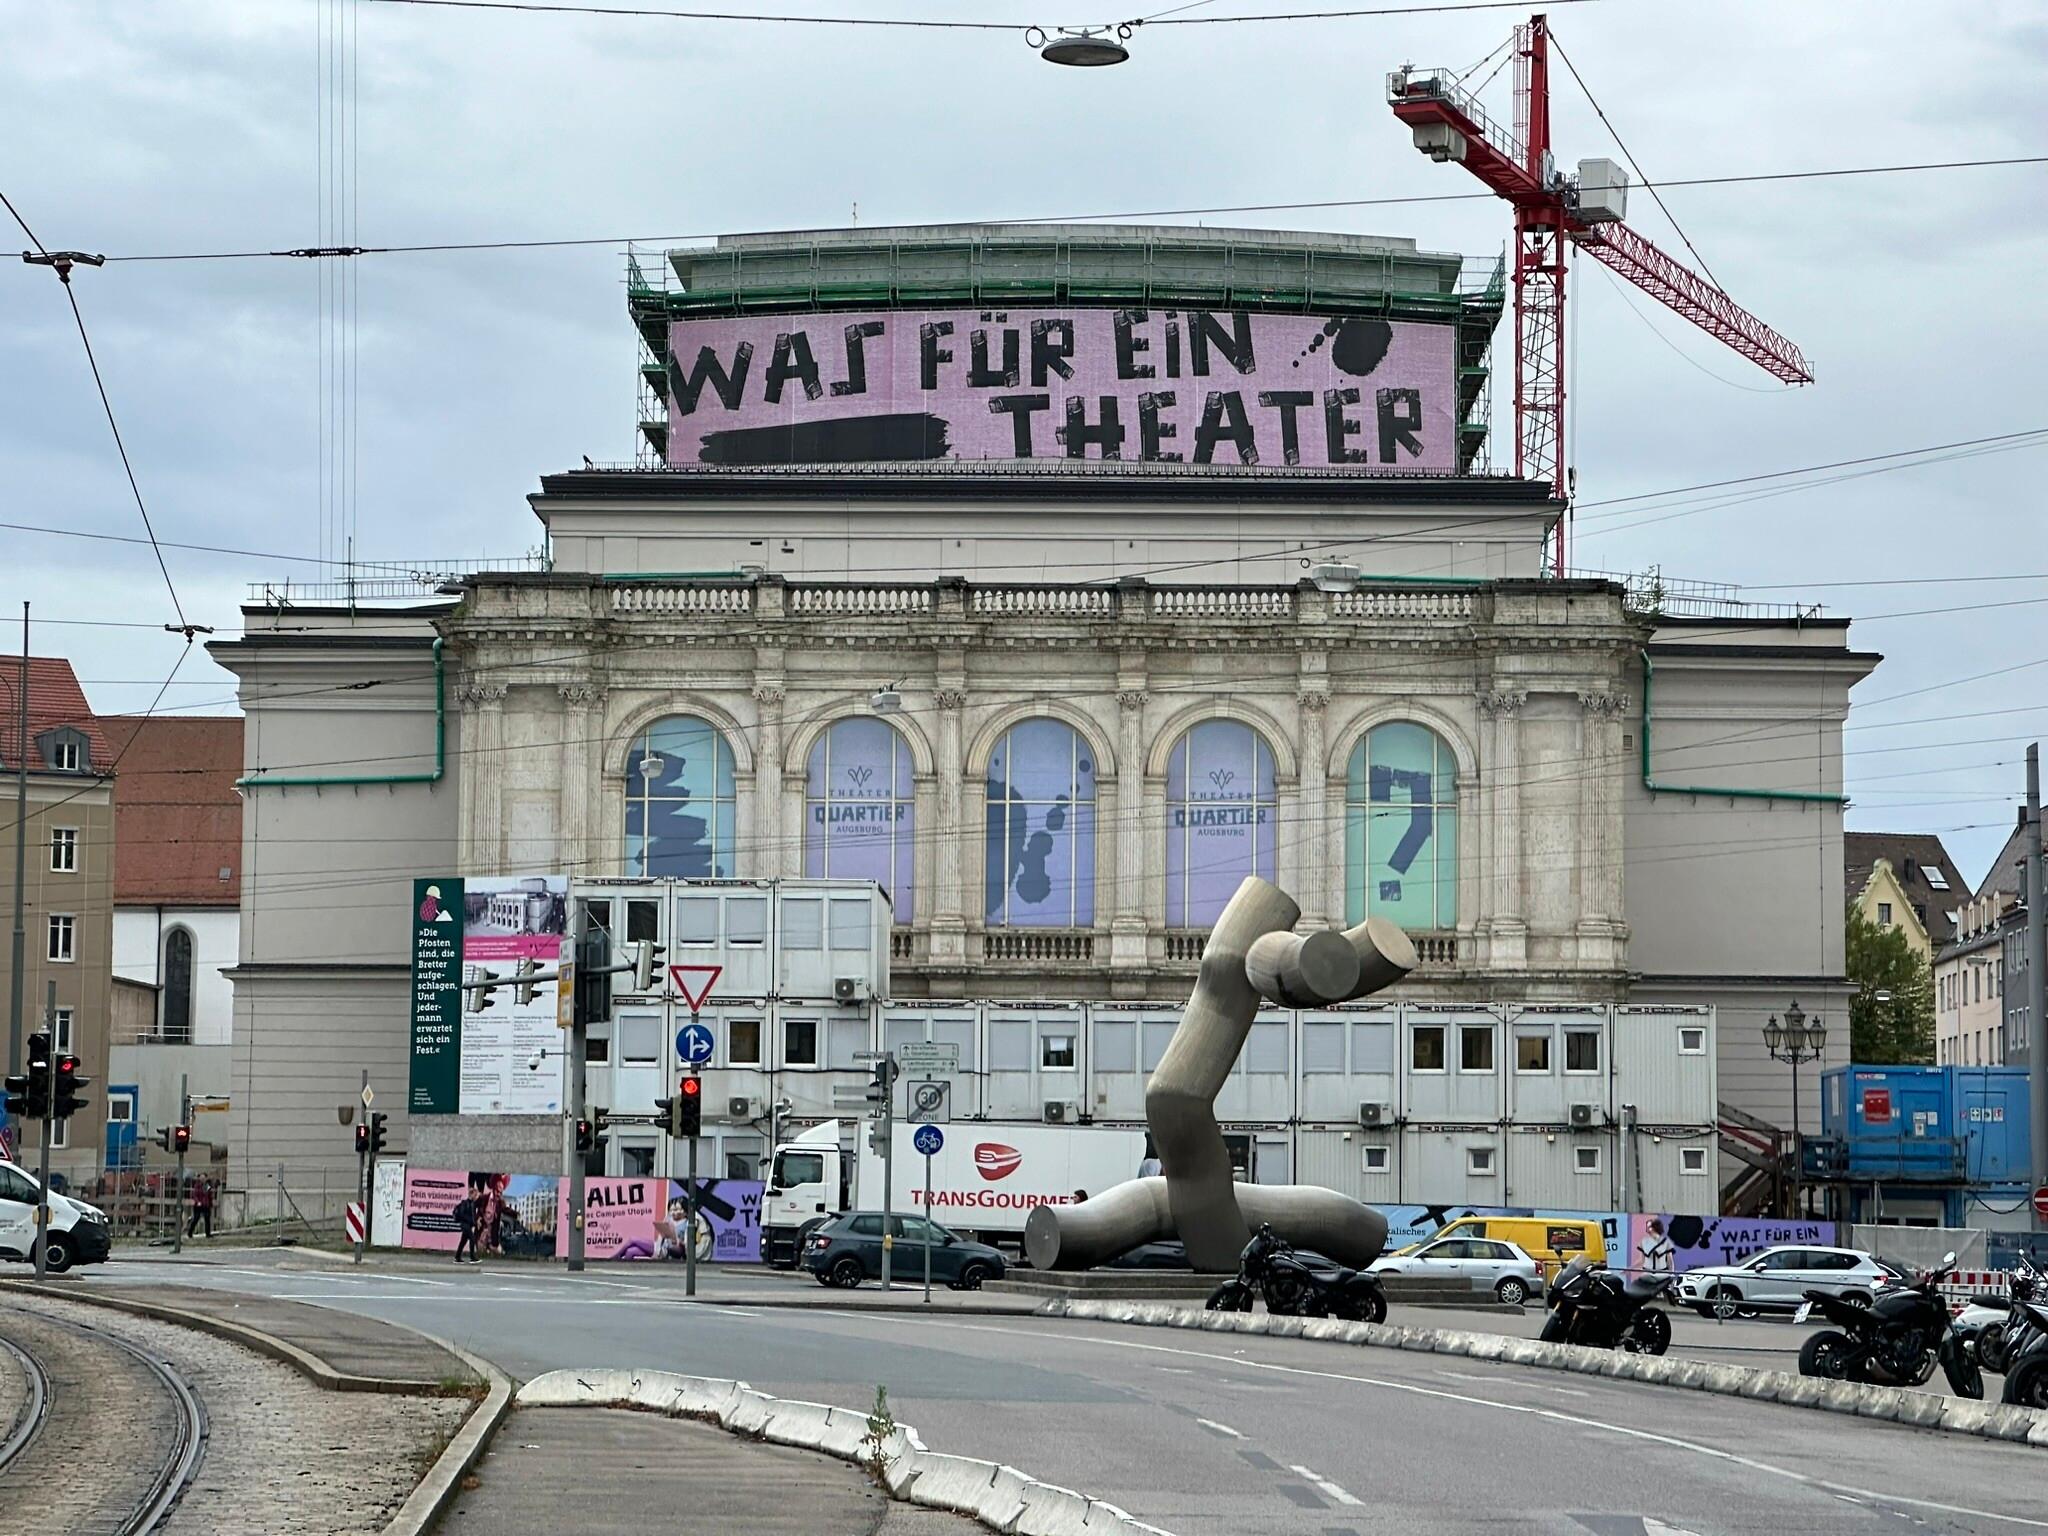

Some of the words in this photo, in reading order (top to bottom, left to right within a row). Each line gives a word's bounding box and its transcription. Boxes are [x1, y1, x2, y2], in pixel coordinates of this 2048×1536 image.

[669, 320, 885, 417] WAS
[920, 311, 1076, 390] FÜR
[988, 388, 1425, 467] THEATER
[829, 789, 891, 797] THEATER
[1190, 792, 1252, 800] THEATER
[836, 825, 883, 834] AUGSBURG
[1197, 829, 1245, 837] AUGSBURG
[418, 939, 451, 948] Pfosten
[418, 949, 440, 958] sind,
[441, 949, 455, 958] die
[418, 960, 448, 969] Bretter
[417, 971, 446, 981] aufge-
[417, 982, 458, 991] schlagen,
[417, 993, 435, 1001] Und
[416, 1003, 442, 1013] jeder-
[416, 1014, 442, 1022] mann
[416, 1025, 453, 1033] erwartet
[416, 1035, 434, 1043] sich
[921, 1092, 937, 1105] 30
[587, 1184, 645, 1208] ALLO
[595, 1209, 626, 1218] Campus
[627, 1207, 653, 1216] Utopia
[1721, 1229, 1760, 1242] WAS
[1765, 1227, 1791, 1241] FÜR
[1796, 1226, 1820, 1240] EIN
